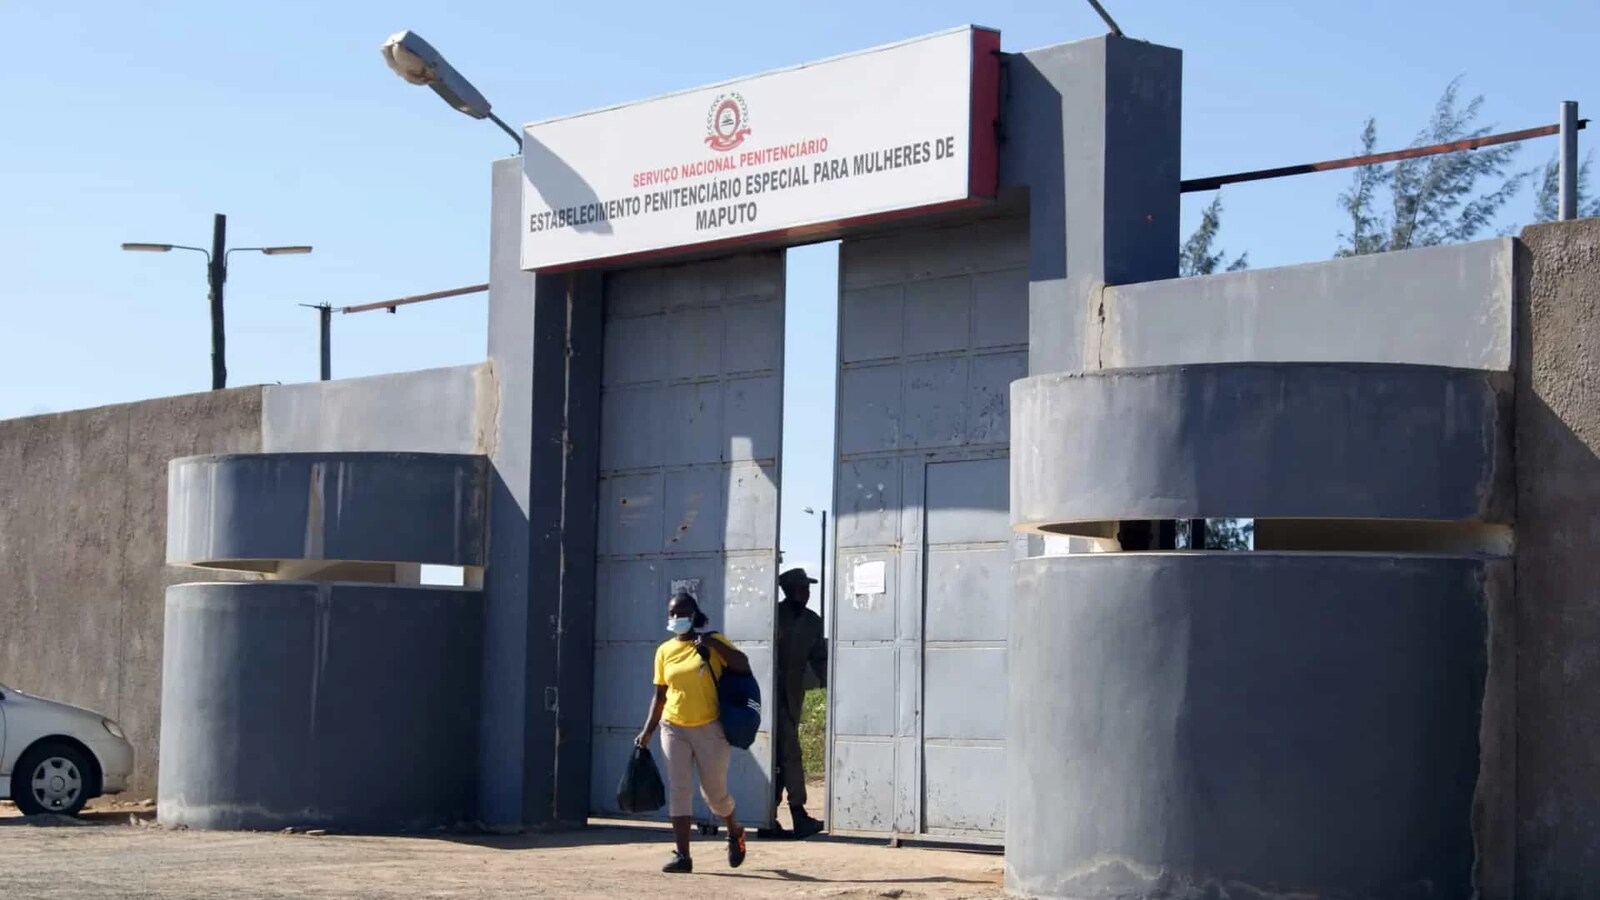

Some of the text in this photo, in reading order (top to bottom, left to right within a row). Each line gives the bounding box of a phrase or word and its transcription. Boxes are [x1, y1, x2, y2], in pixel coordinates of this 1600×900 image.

[530, 136, 954, 232] ESTABELECIMENTO PENITENCIÁRIO ESPECIAL PARA MULHERES DE
[633, 138, 828, 188] SERVIÇO NACIONAL PENITENCIÁRIO
[696, 202, 757, 230] MAPUTO
